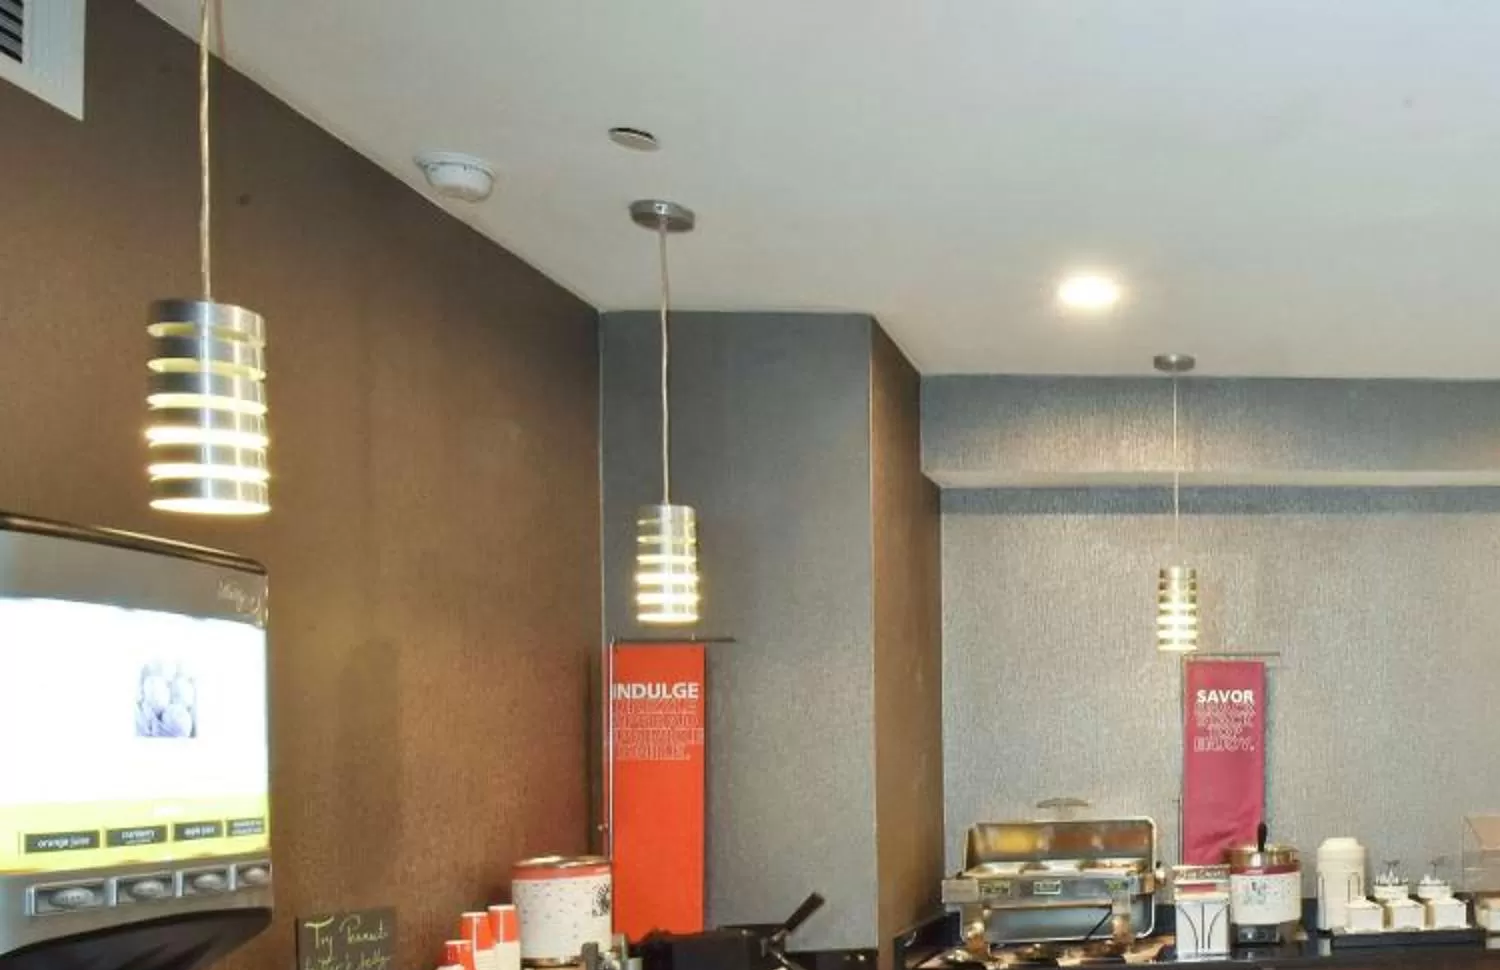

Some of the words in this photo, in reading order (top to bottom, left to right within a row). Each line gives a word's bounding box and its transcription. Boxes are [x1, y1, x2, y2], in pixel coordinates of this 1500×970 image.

[612, 682, 699, 699] INDULGE
[1196, 689, 1255, 703] SAVOR
[37, 838, 69, 849] orange
[304, 916, 334, 960] Try
